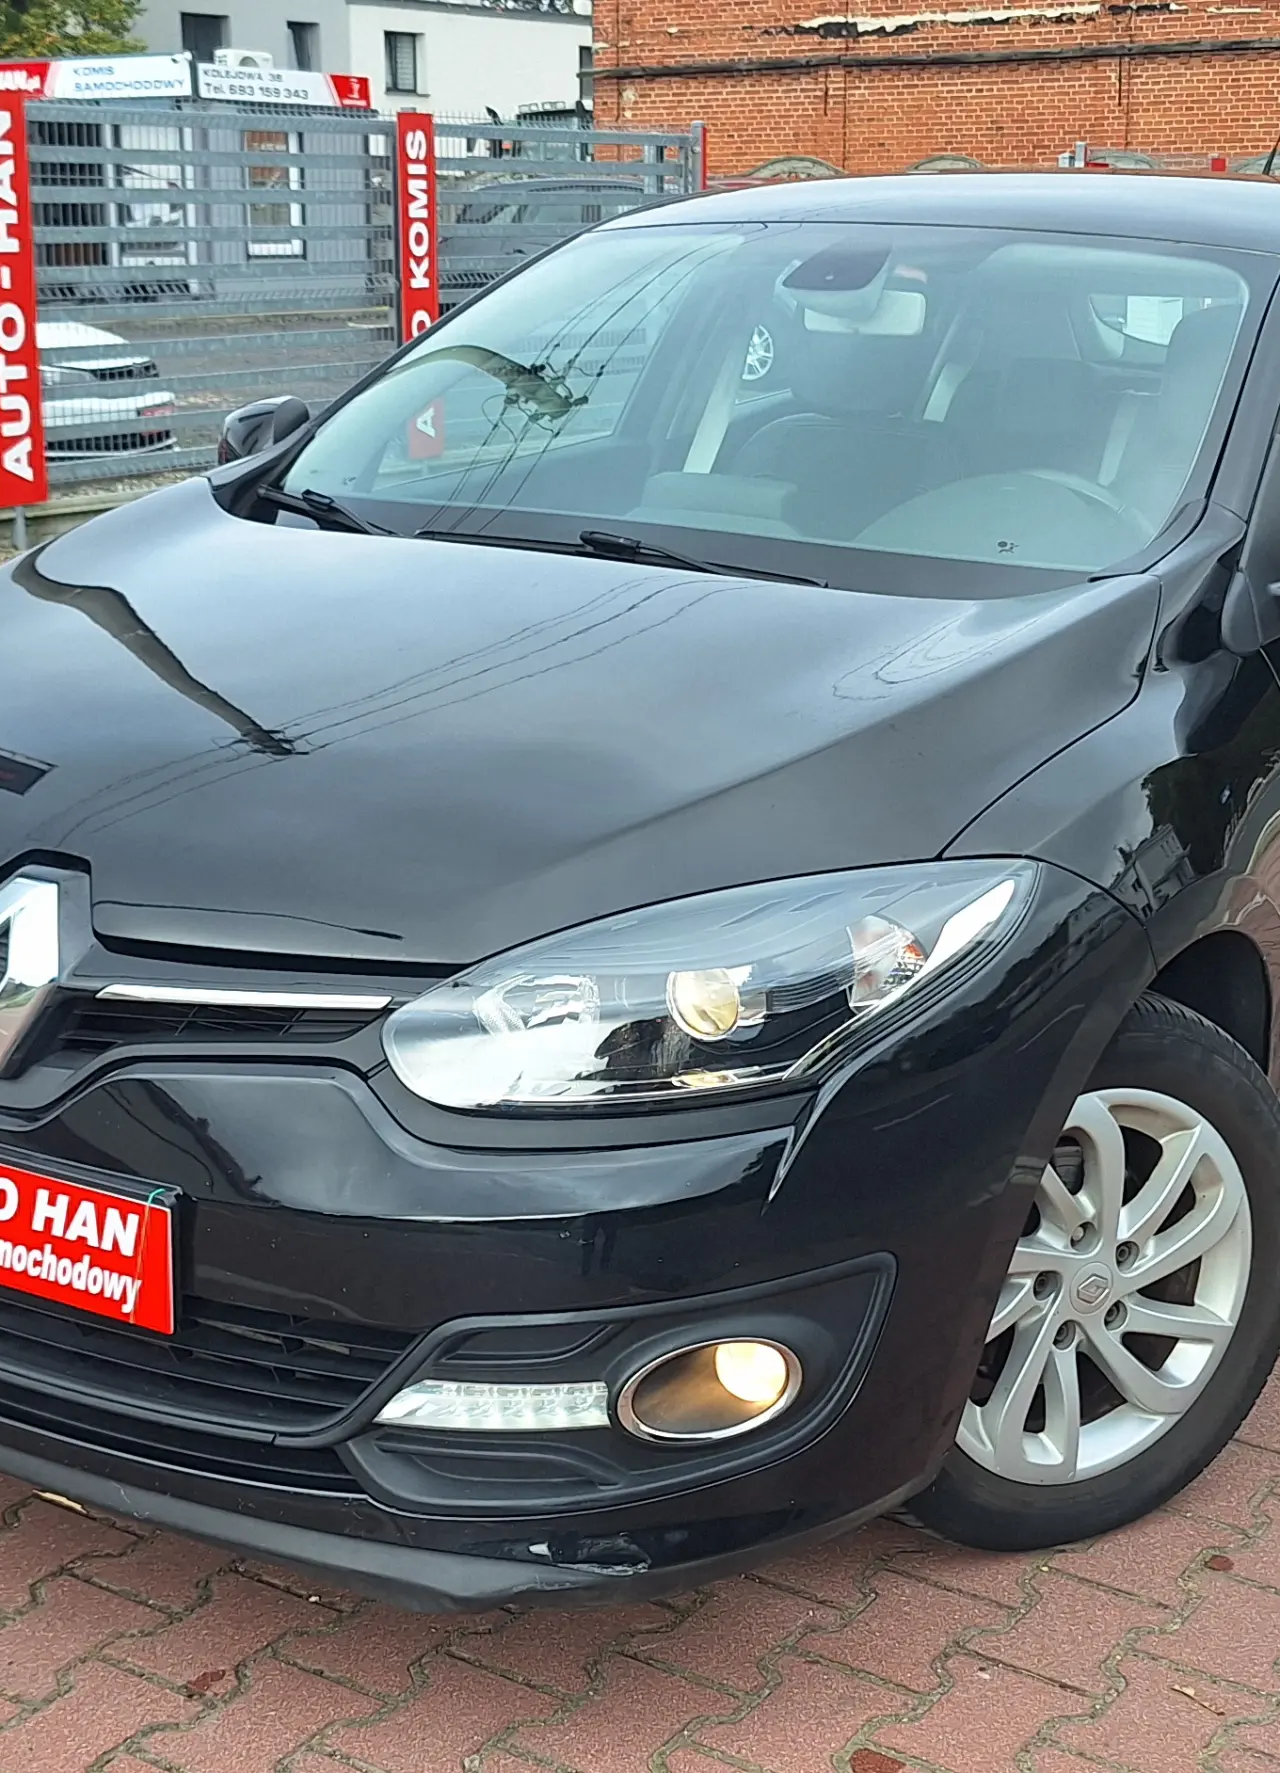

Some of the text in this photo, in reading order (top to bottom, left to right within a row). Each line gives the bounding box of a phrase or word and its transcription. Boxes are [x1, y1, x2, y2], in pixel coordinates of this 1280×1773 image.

[73, 66, 115, 77] KOMIS
[203, 68, 264, 82] KOLEJOWA
[284, 88, 309, 100] 343
[405, 130, 430, 289] KOMIS
[30, 1187, 141, 1258] HAN
